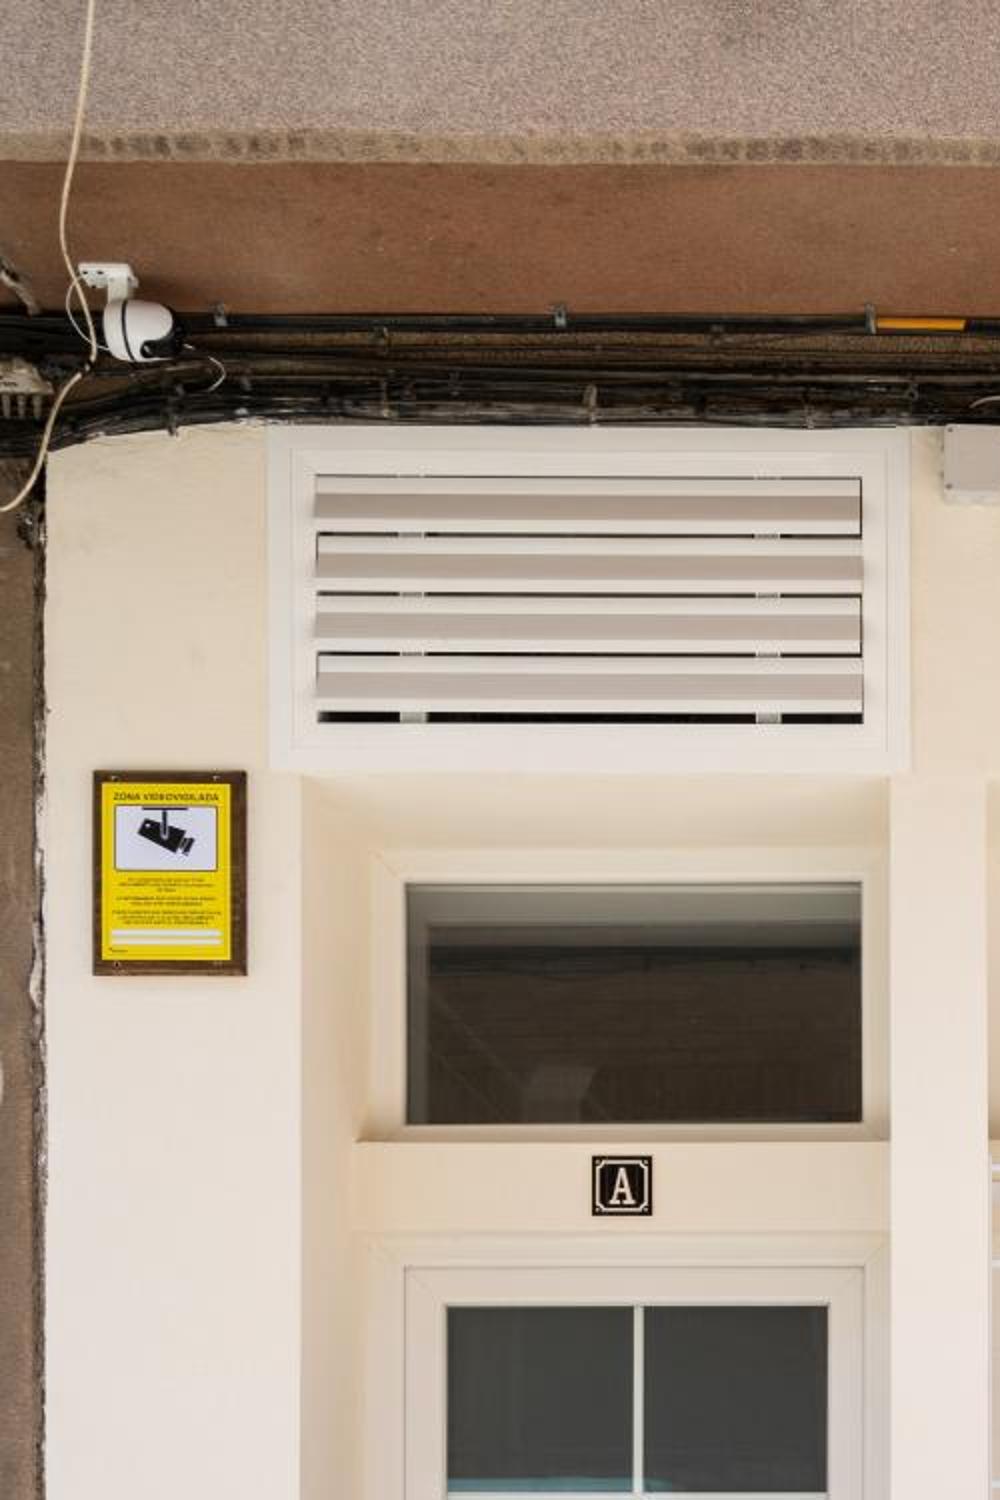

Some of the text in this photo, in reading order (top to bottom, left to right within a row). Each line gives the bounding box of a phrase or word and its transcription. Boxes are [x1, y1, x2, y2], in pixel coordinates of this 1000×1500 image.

[113, 791, 219, 801] ZONA VIDEOVIGILADA
[609, 1167, 636, 1205] A
